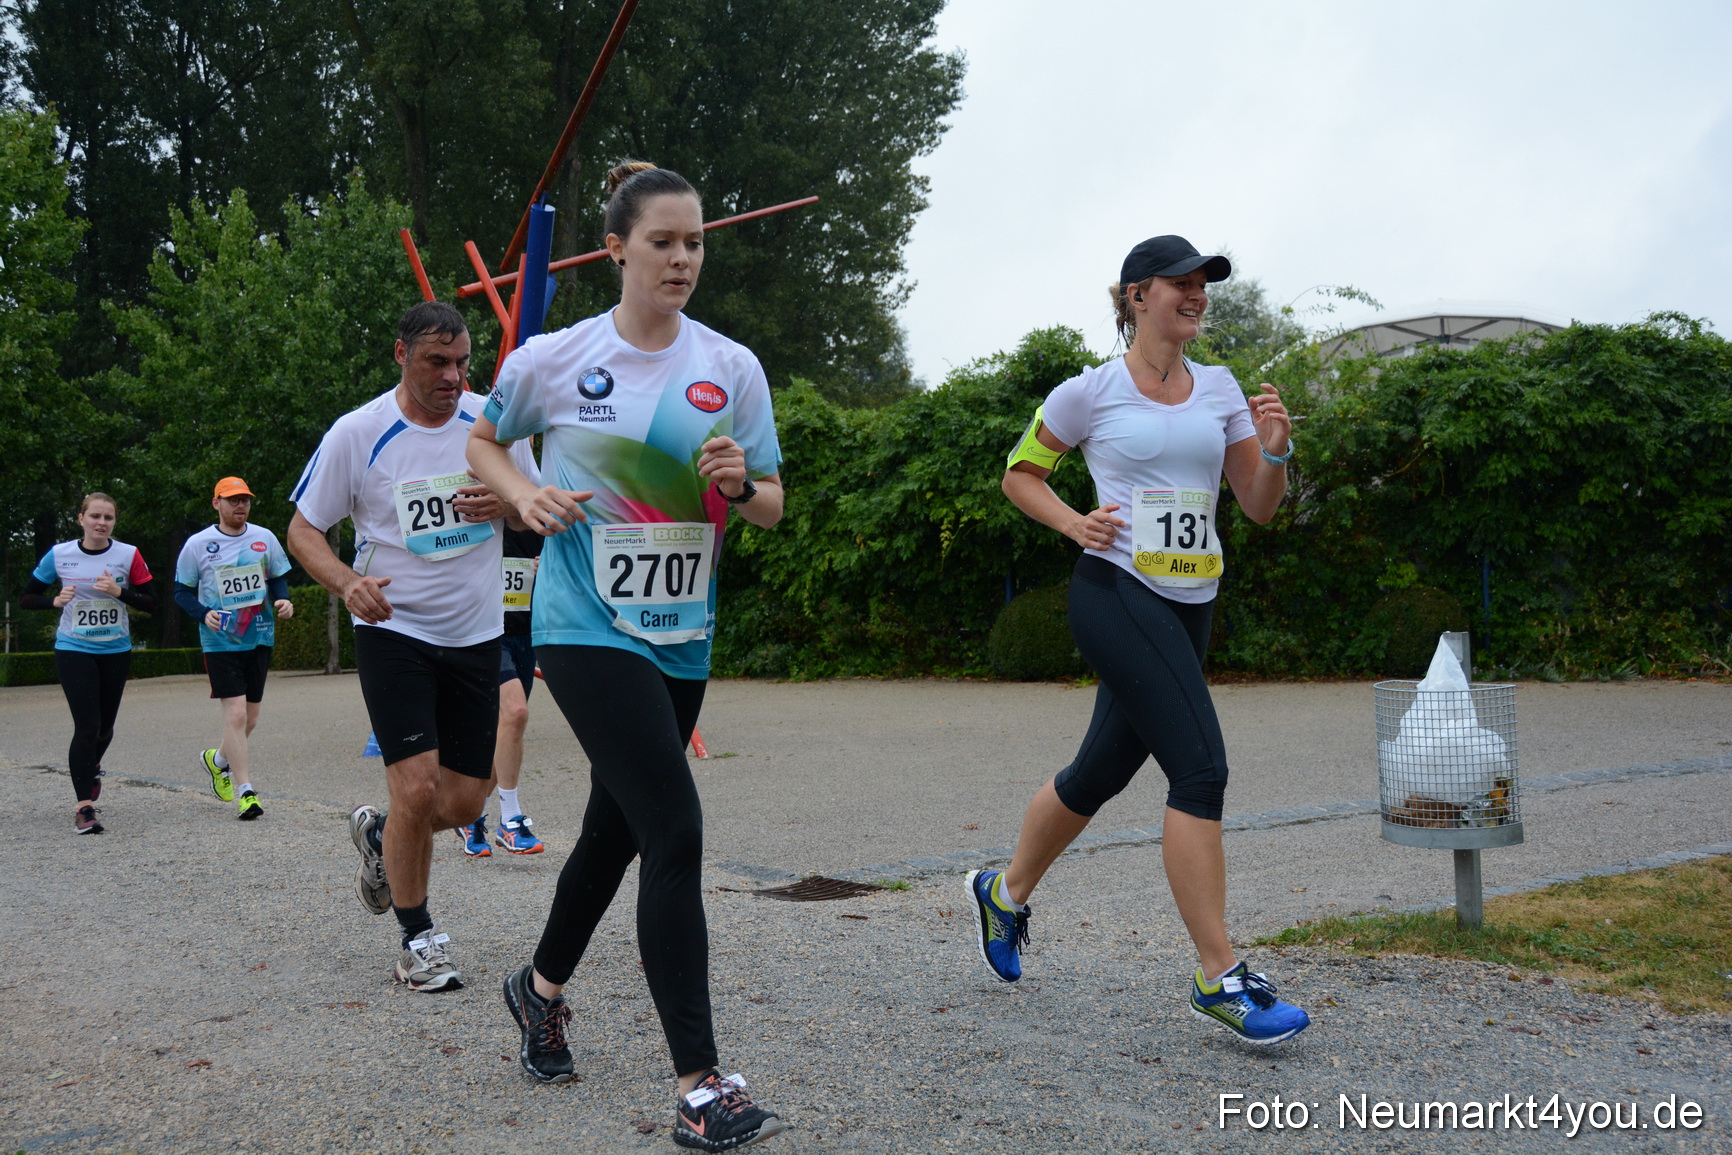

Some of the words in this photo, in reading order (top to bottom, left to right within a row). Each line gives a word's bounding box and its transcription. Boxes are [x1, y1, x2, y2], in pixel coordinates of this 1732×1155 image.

[580, 367, 610, 379] BMW
[578, 405, 616, 415] PARTL
[401, 486, 431, 496] NeuerMarkt
[1182, 492, 1210, 506] BOC
[653, 527, 704, 541] BOCK
[1157, 512, 1207, 549] 137
[435, 532, 469, 548] Armin
[1170, 558, 1197, 573] Alex
[610, 553, 701, 598] 2707
[223, 574, 261, 594] 2612
[233, 594, 256, 603] Thomas
[78, 609, 118, 626] 2669
[640, 610, 679, 628] Carra
[86, 628, 111, 636] Hannah
